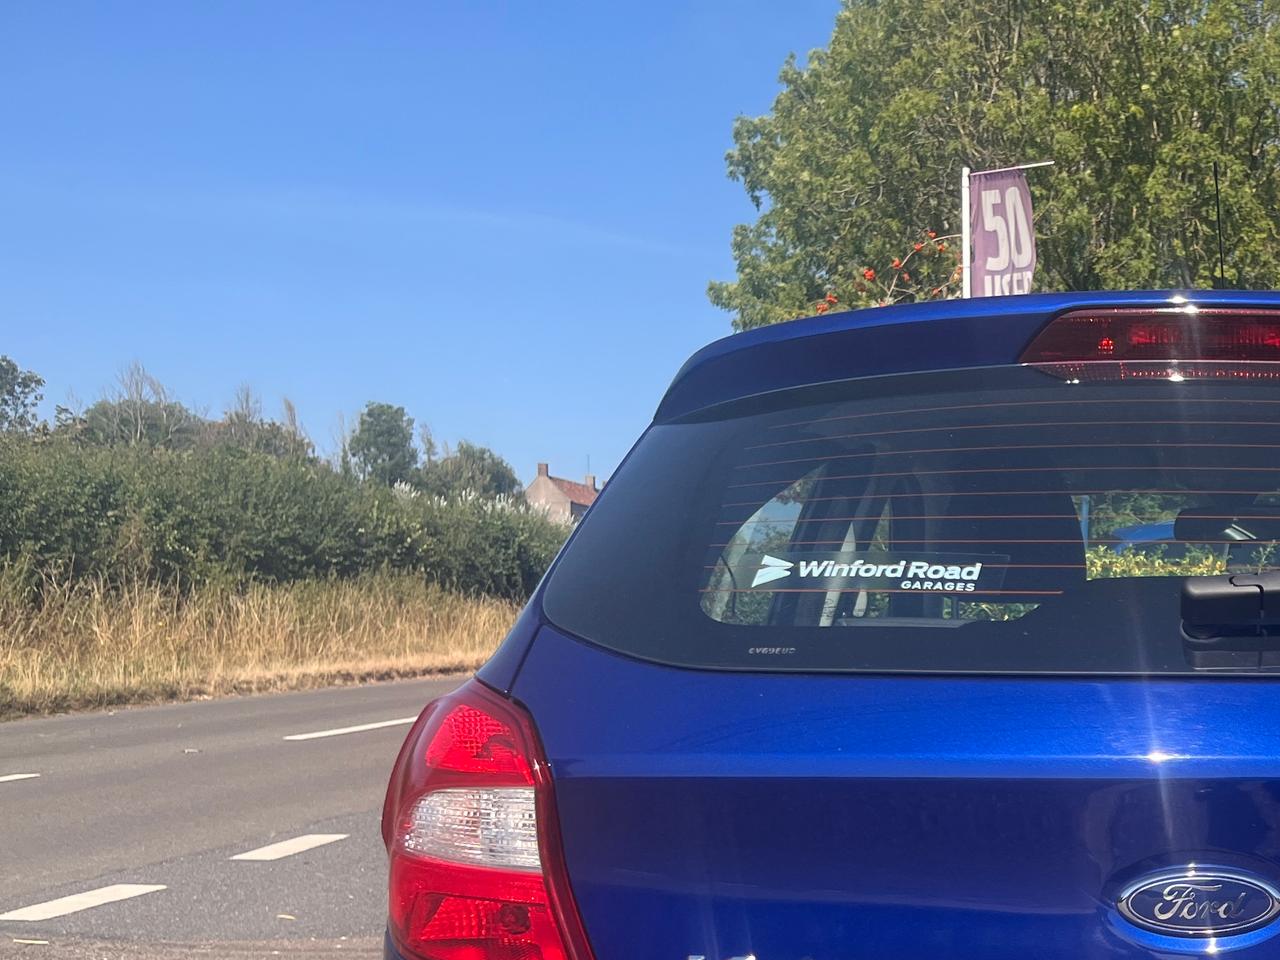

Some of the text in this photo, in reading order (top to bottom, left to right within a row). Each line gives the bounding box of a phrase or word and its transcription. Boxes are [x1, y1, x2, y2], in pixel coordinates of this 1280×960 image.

[982, 186, 1032, 271] 50
[800, 560, 982, 581] Winford Road
[901, 580, 976, 592] GARAGES
[1154, 883, 1246, 920] Ford
